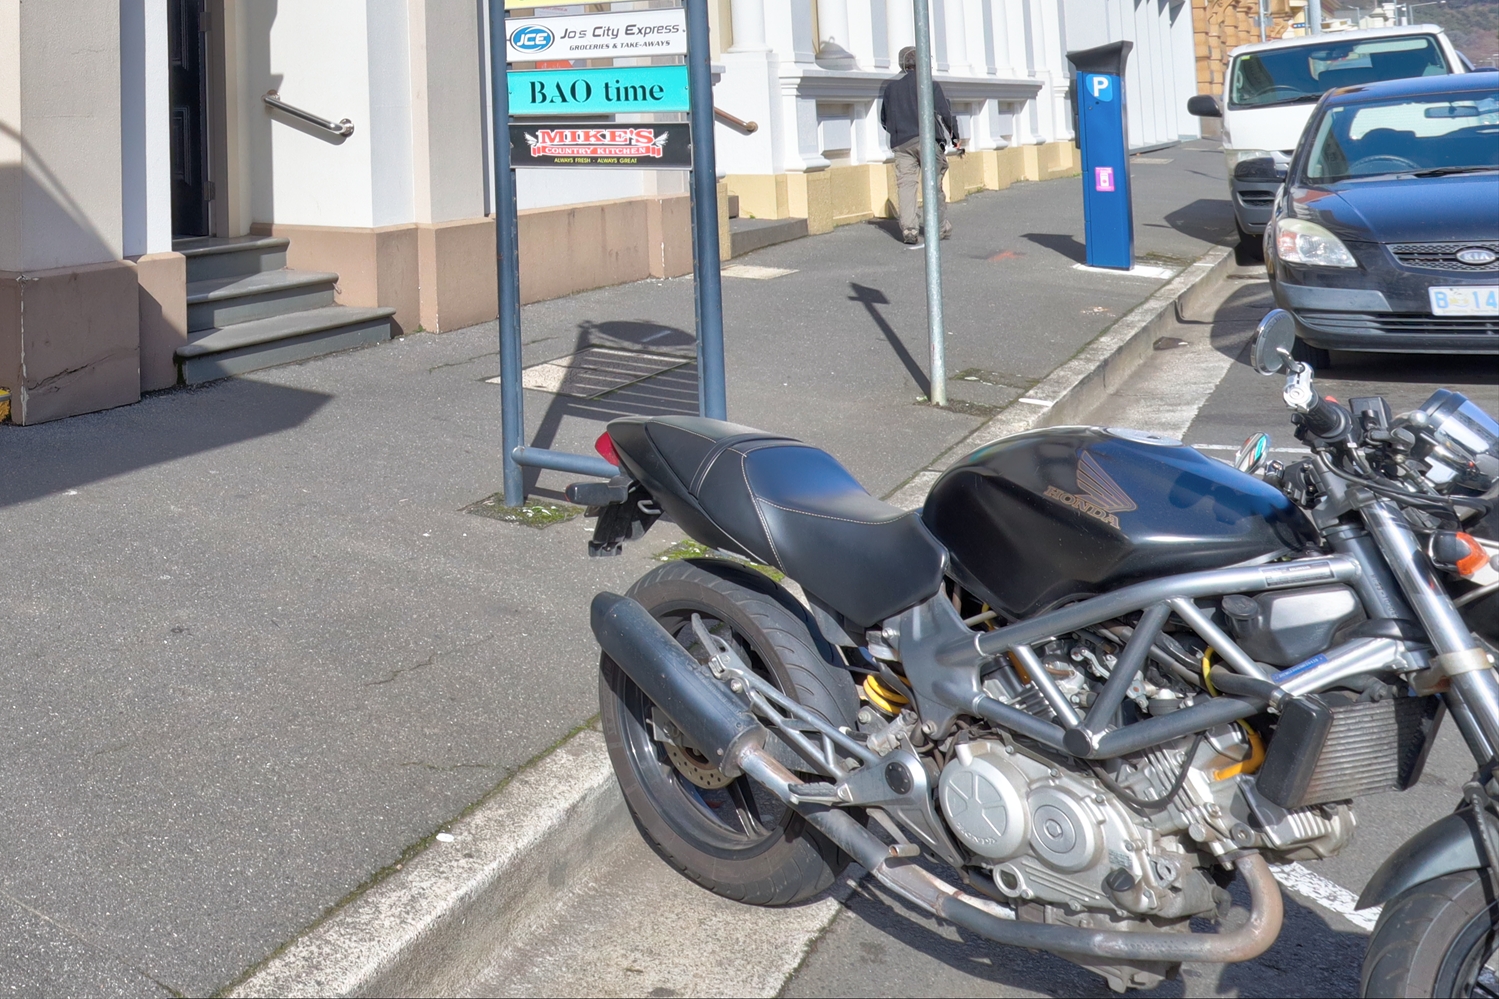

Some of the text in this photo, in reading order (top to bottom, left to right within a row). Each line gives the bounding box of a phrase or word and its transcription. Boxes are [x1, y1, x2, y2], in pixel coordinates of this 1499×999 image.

[516, 32, 548, 46] JCE
[592, 26, 620, 39] City
[624, 24, 680, 37] Express
[569, 43, 610, 51] GROCERIES
[620, 40, 671, 49] TAKE-AWAYS
[529, 79, 664, 104] BAO time
[1093, 76, 1109, 97] P
[539, 128, 655, 145] MIKE'S
[1463, 252, 1489, 260] KIA
[1434, 290, 1498, 308] B 14
[1042, 485, 1121, 530] HONDA
